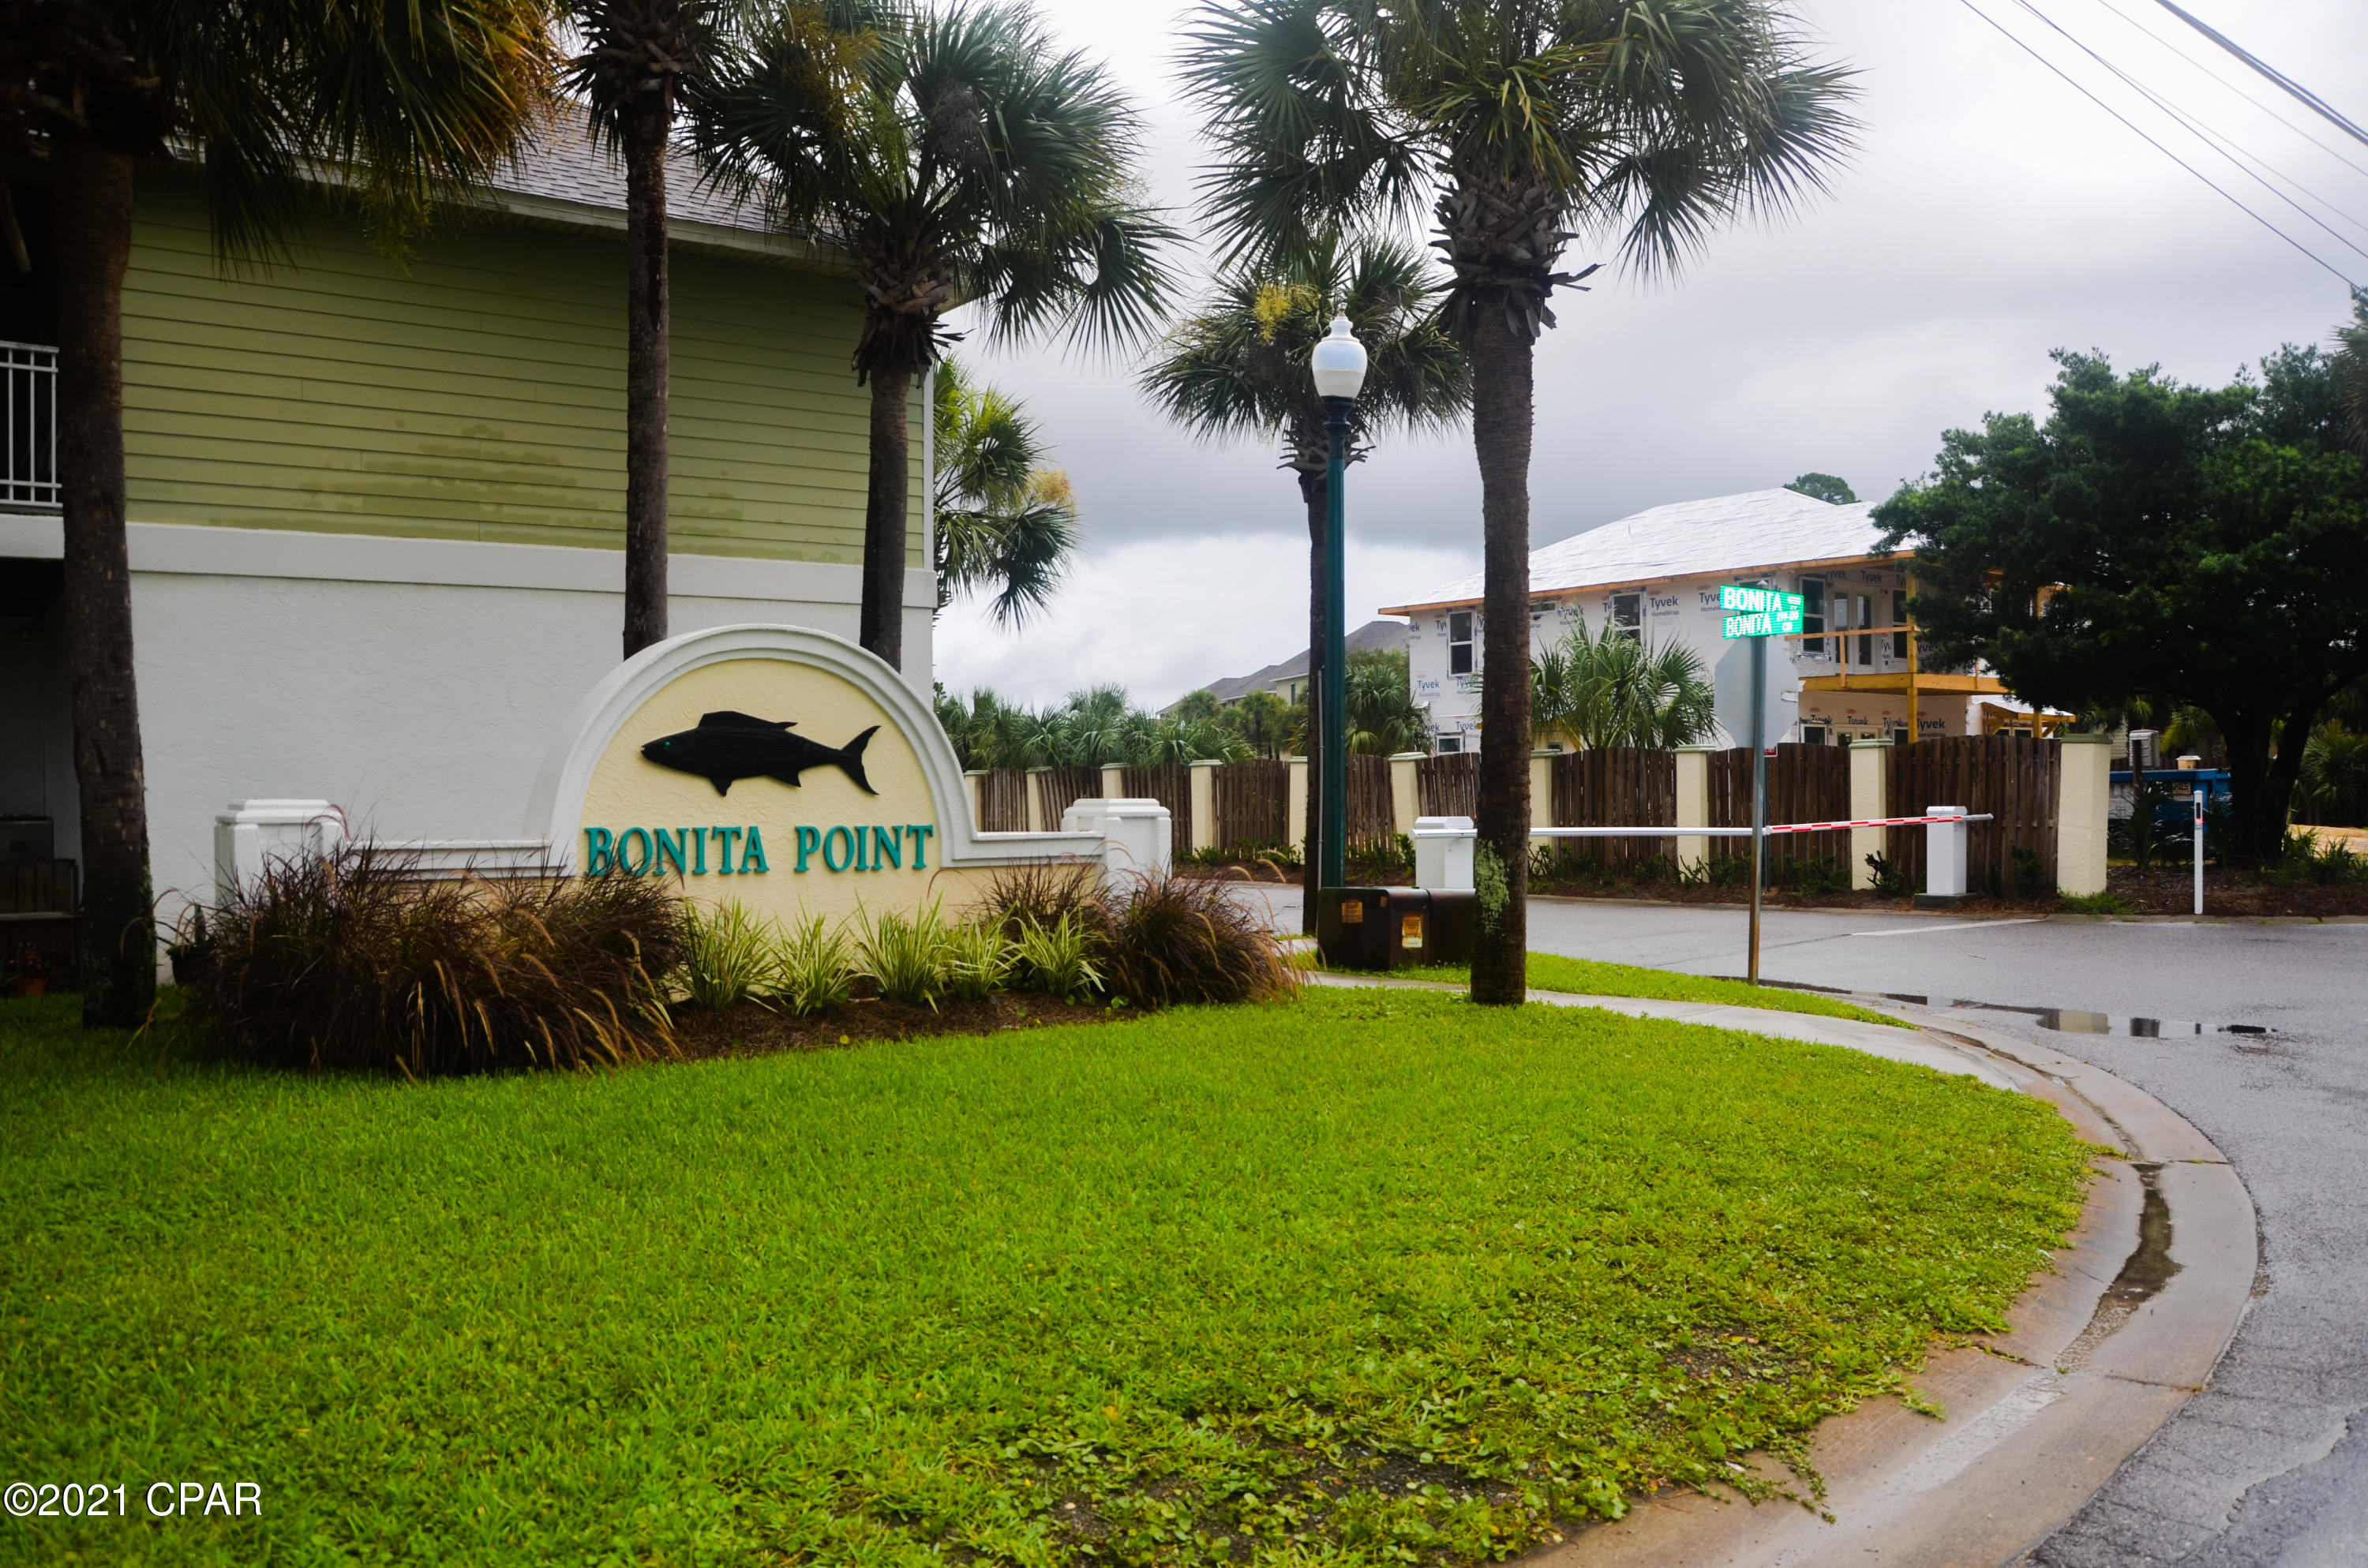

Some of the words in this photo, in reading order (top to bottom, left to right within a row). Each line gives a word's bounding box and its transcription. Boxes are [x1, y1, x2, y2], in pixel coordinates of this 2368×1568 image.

[1650, 596, 1679, 610] Tyvek
[1699, 592, 1721, 605] Tyve
[1724, 587, 1782, 612] BONITA
[1726, 612, 1773, 637] BONITA
[1418, 679, 1440, 691] Tyvek
[585, 826, 770, 876] BONITA
[793, 824, 934, 872] POINT
